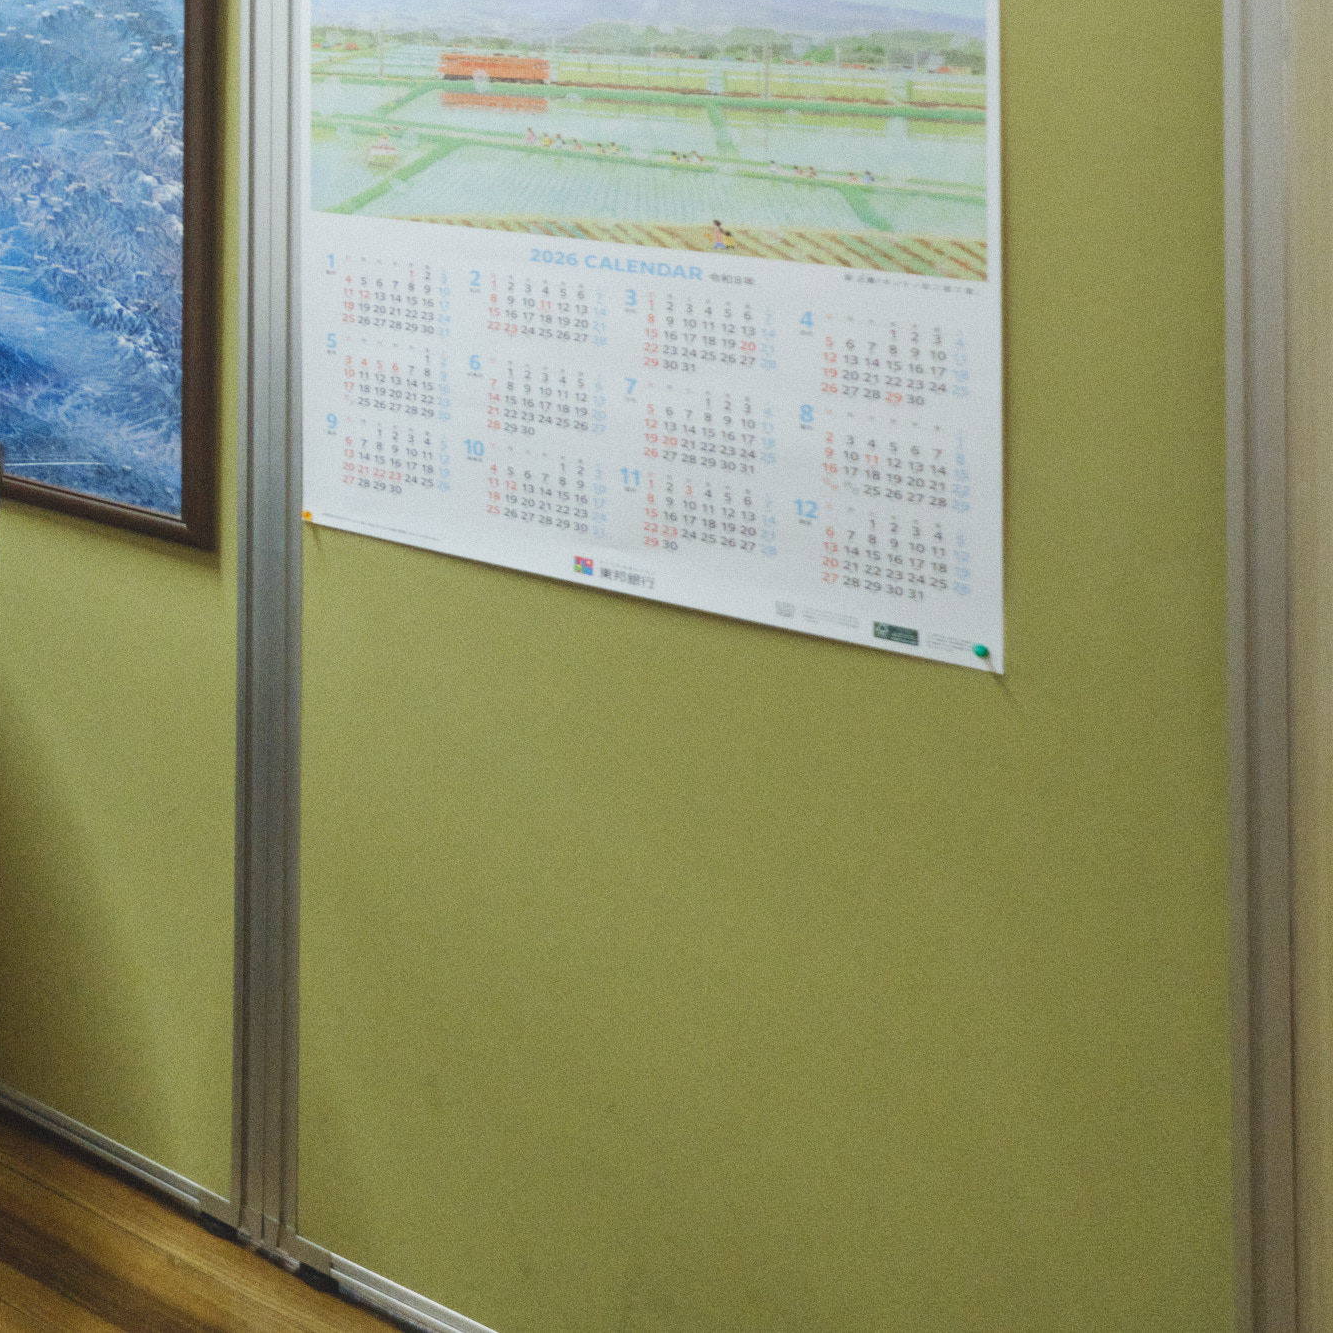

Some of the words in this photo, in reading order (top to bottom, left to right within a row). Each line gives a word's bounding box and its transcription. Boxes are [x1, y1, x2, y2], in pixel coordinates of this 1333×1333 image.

[327, 253, 334, 269] 1
[530, 248, 578, 266] 2026
[584, 254, 703, 281] CALENDAR
[409, 269, 414, 278] 1
[425, 271, 431, 280] 2
[469, 270, 481, 287] 2
[361, 277, 367, 286] 5
[376, 279, 383, 288] 6
[393, 280, 398, 288] 7
[408, 283, 414, 291] 8
[424, 285, 431, 295] 9
[359, 290, 370, 299] 12
[375, 292, 386, 301] 13
[391, 294, 402, 302] 14
[407, 296, 418, 306] 15
[423, 299, 434, 307] 16
[625, 289, 637, 306] 3
[344, 301, 354, 310] 18
[359, 303, 371, 312] 19
[374, 305, 387, 314] 20
[390, 307, 400, 315] 21
[406, 309, 417, 318] 22
[421, 311, 434, 322] 23
[799, 311, 814, 328] 4
[342, 313, 356, 323] 25
[358, 316, 371, 325] 26
[374, 318, 387, 327] 27
[390, 321, 402, 329] 28
[405, 323, 419, 333] 29
[422, 325, 435, 335] 30
[326, 332, 337, 348] 5
[469, 354, 481, 371] 6
[624, 377, 637, 395] 7
[326, 413, 337, 429] 9
[799, 404, 814, 423] 8
[464, 439, 484, 457] 10
[619, 467, 640, 486] 11
[793, 499, 819, 519] 12
[599, 566, 655, 589] 東邦銀行
[822, 556, 839, 568] 20
[844, 561, 858, 571] 21
[865, 565, 882, 576] 22
[887, 569, 903, 580] 23
[909, 573, 926, 584] 24
[930, 578, 948, 589] 25
[822, 572, 838, 583] 27
[844, 576, 861, 587] 28
[865, 580, 882, 592] 29
[887, 585, 904, 596] 30
[909, 589, 924, 599] 31
